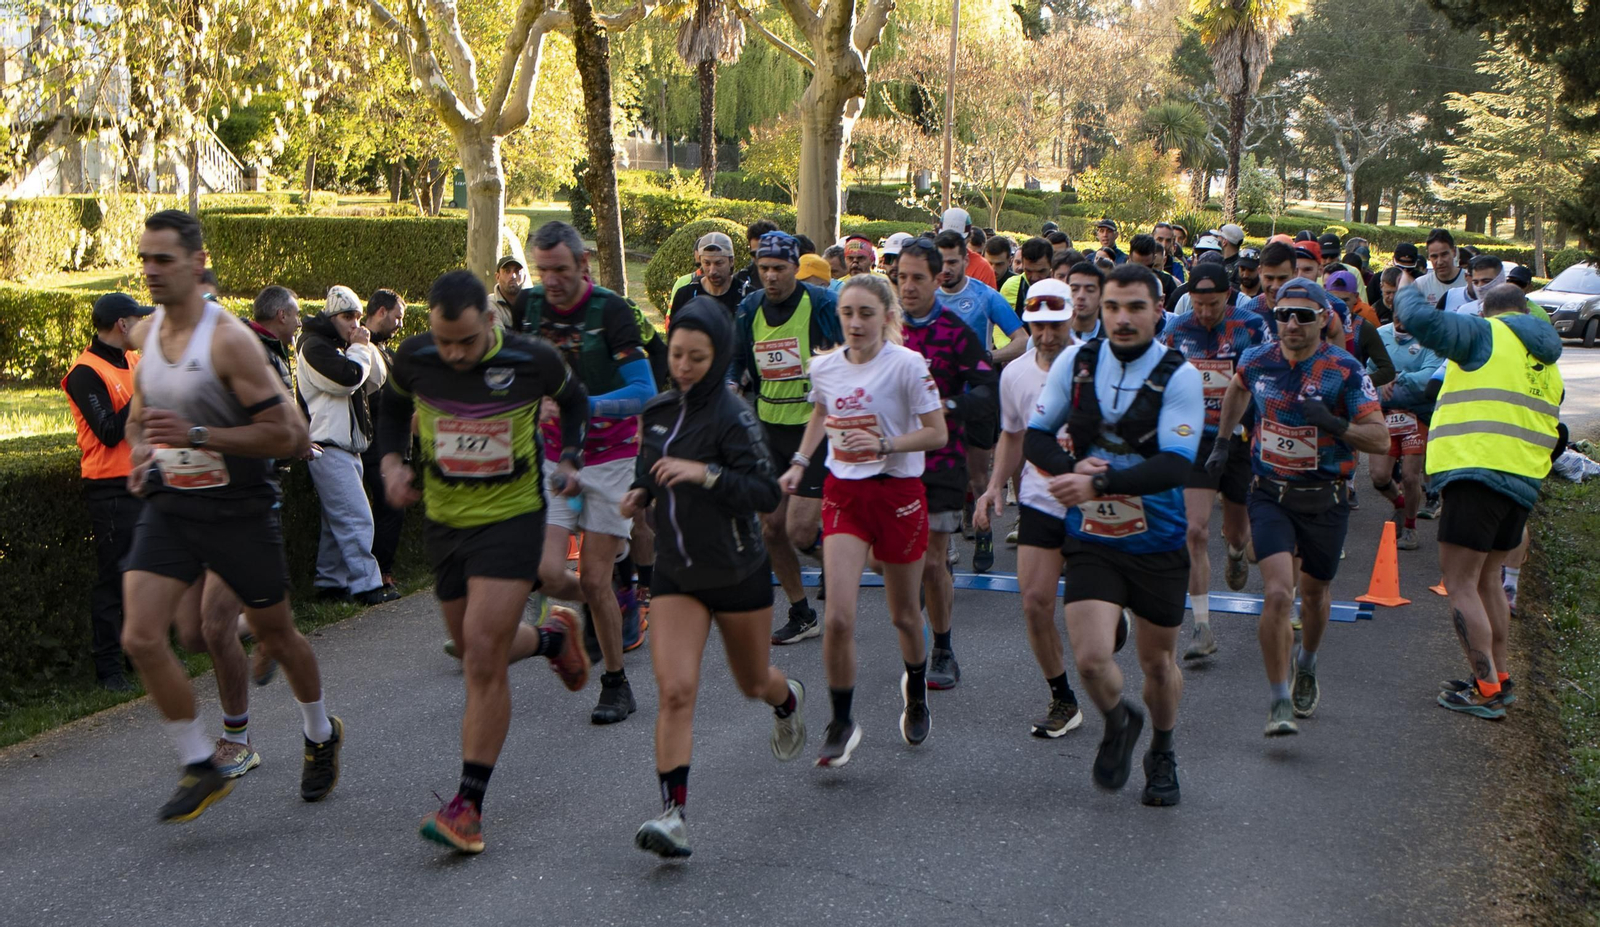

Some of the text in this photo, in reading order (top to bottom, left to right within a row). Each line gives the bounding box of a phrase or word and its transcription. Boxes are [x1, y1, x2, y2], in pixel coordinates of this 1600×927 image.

[767, 351, 783, 363] 30
[1390, 413, 1405, 424] 116
[455, 434, 490, 453] 127
[1277, 437, 1295, 451] 29
[177, 450, 192, 465] 2
[1096, 502, 1117, 517] 41
